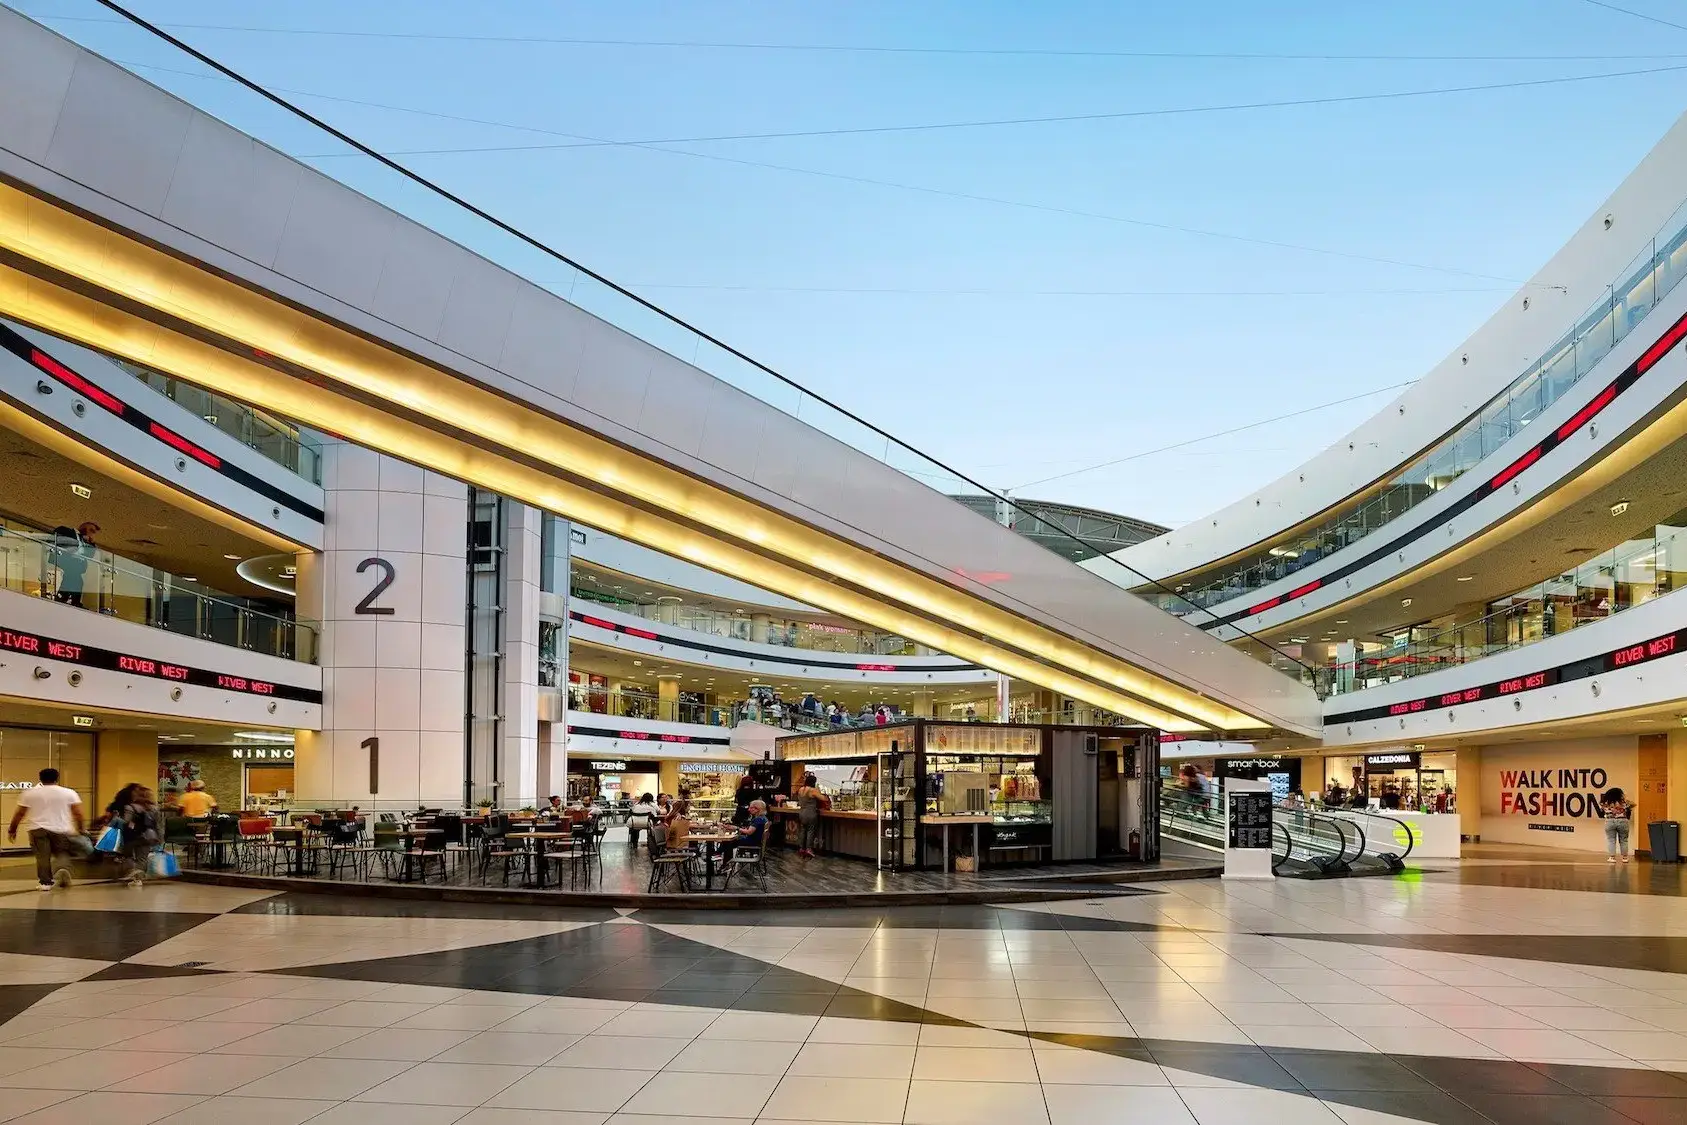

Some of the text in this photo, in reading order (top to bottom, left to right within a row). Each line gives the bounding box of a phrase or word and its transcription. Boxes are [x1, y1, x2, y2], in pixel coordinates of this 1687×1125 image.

[355, 557, 395, 615] 2
[48, 641, 82, 660] WEST
[1615, 635, 1675, 665] RIVER WEST
[120, 656, 189, 680] RIVER WEST
[251, 681, 275, 694] WEST
[1500, 673, 1545, 694] RIVER WEST
[1441, 688, 1481, 706] RIVER WEST
[361, 737, 379, 795] 1
[591, 761, 626, 771] TEZENIS
[681, 763, 744, 772] ENGLISH HOME
[1227, 758, 1280, 768] smashbox
[1368, 754, 1411, 764] CALZEDONIA
[1500, 768, 1607, 789] WALK INTO
[1230, 798, 1237, 807] 3
[1501, 792, 1606, 819] FASHION
[1230, 814, 1236, 822] 2
